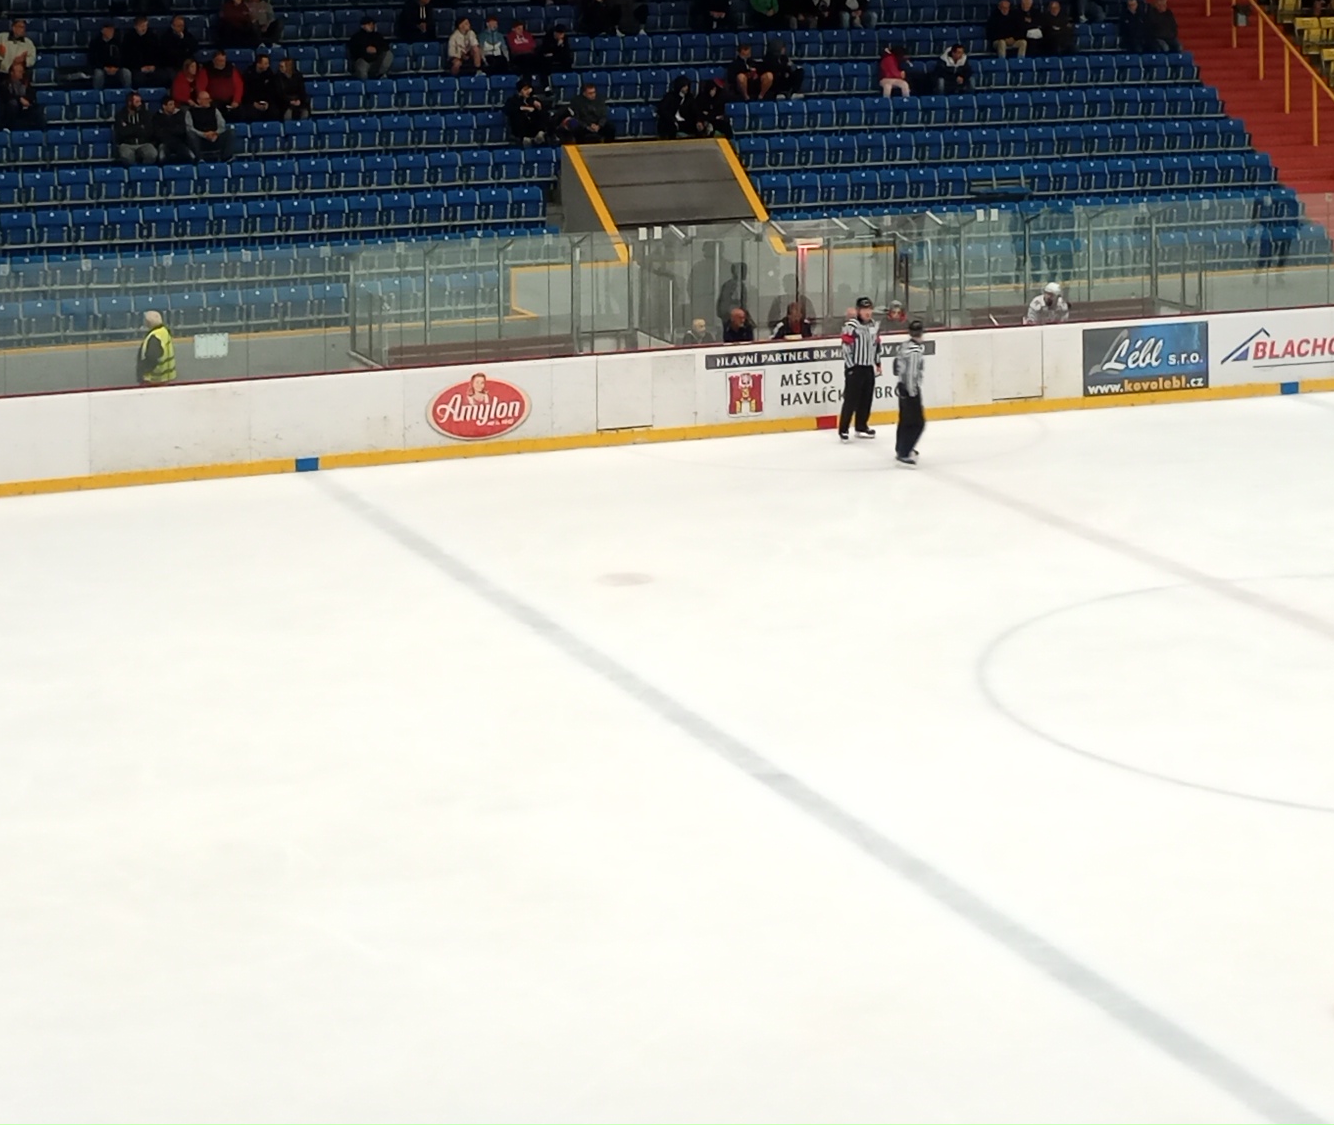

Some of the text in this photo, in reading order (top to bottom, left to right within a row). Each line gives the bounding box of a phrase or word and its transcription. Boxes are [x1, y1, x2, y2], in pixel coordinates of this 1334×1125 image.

[716, 353, 758, 367] HLAVNÍ
[761, 350, 810, 363] PARTNER
[813, 350, 827, 359] BK
[1102, 338, 1204, 370] Lébl s.r.o.
[780, 370, 833, 387] MĚSTO
[1087, 375, 1204, 394] www.kovolebl.cz
[780, 386, 844, 406] HAVLÍČ
[436, 393, 520, 426] Amylon
